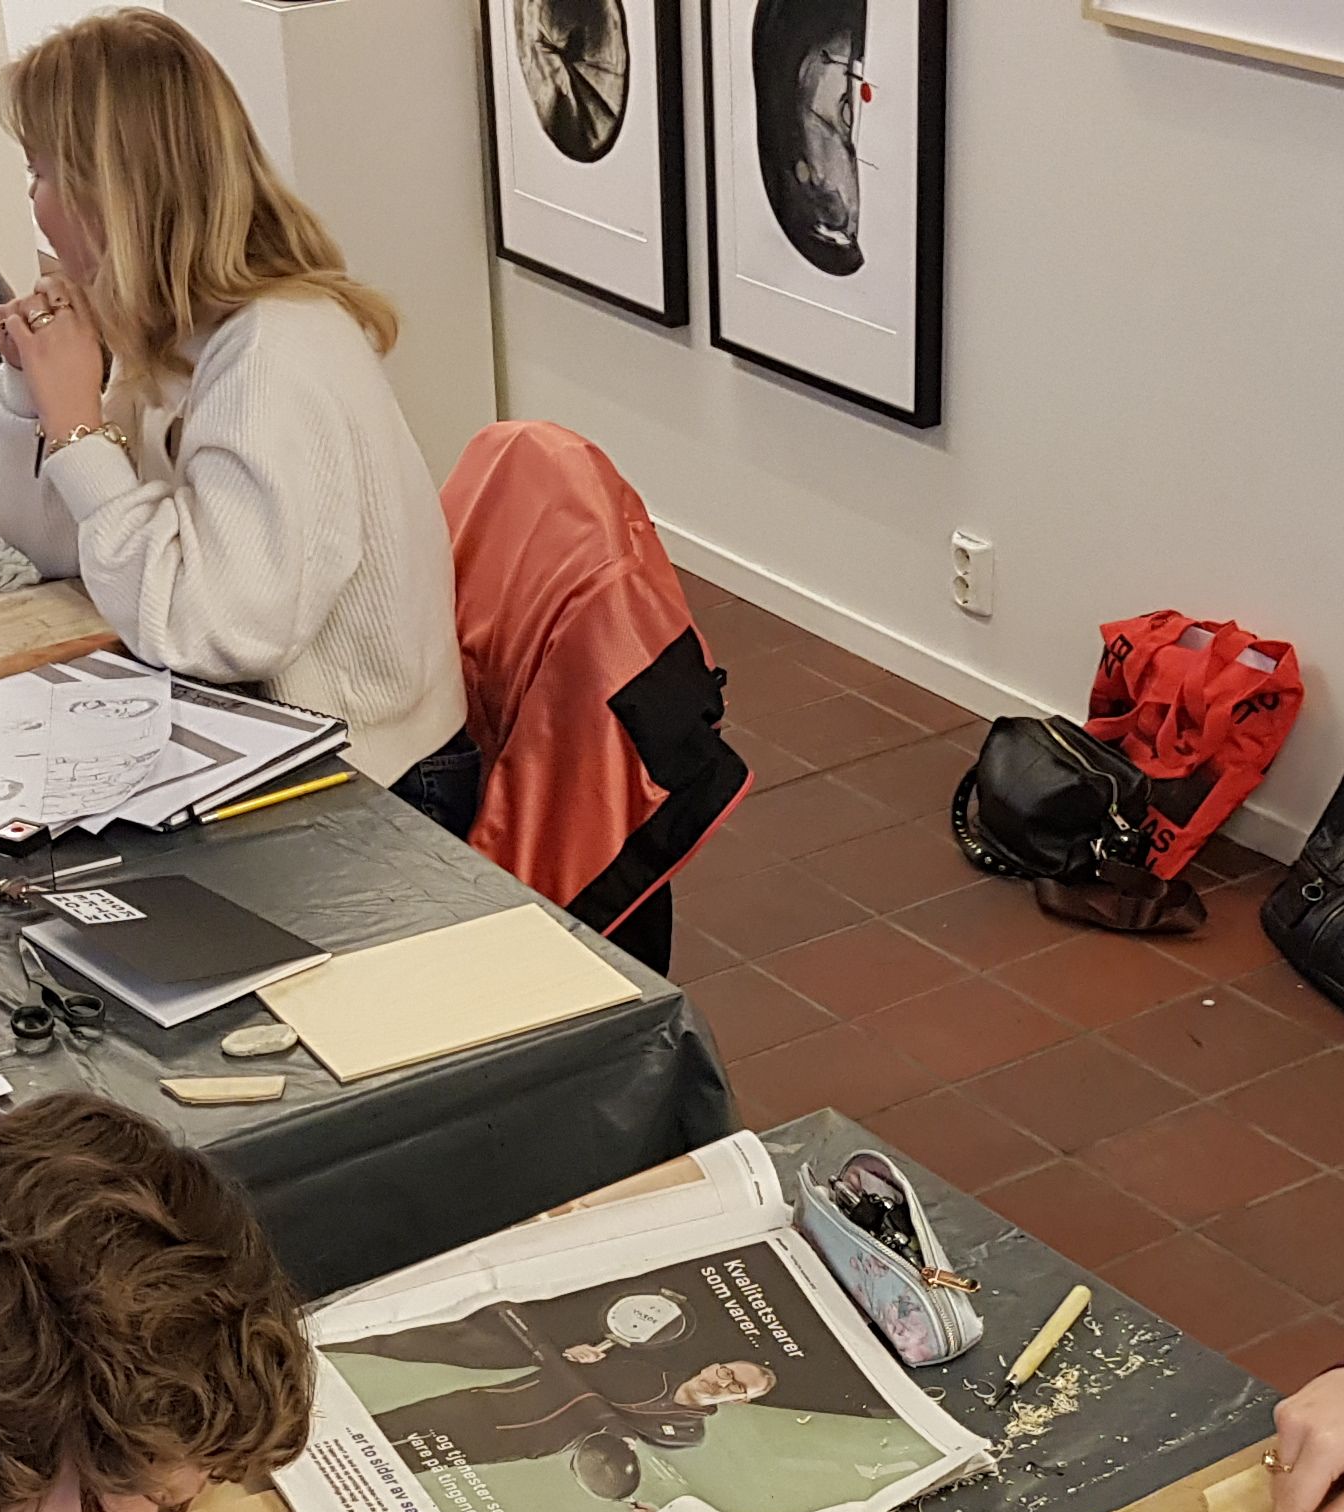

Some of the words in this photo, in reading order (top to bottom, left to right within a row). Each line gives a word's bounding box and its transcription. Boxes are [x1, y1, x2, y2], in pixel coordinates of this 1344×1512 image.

[699, 1262, 732, 1301] som
[723, 1296, 766, 1349] varer...
[722, 1254, 806, 1364] Kvalitetsvarer
[360, 1442, 376, 1459] to
[369, 1456, 397, 1487] sider
[390, 1485, 408, 1501] av
[407, 1431, 433, 1458] vare
[421, 1455, 445, 1473] på
[445, 1447, 494, 1502] tjenester
